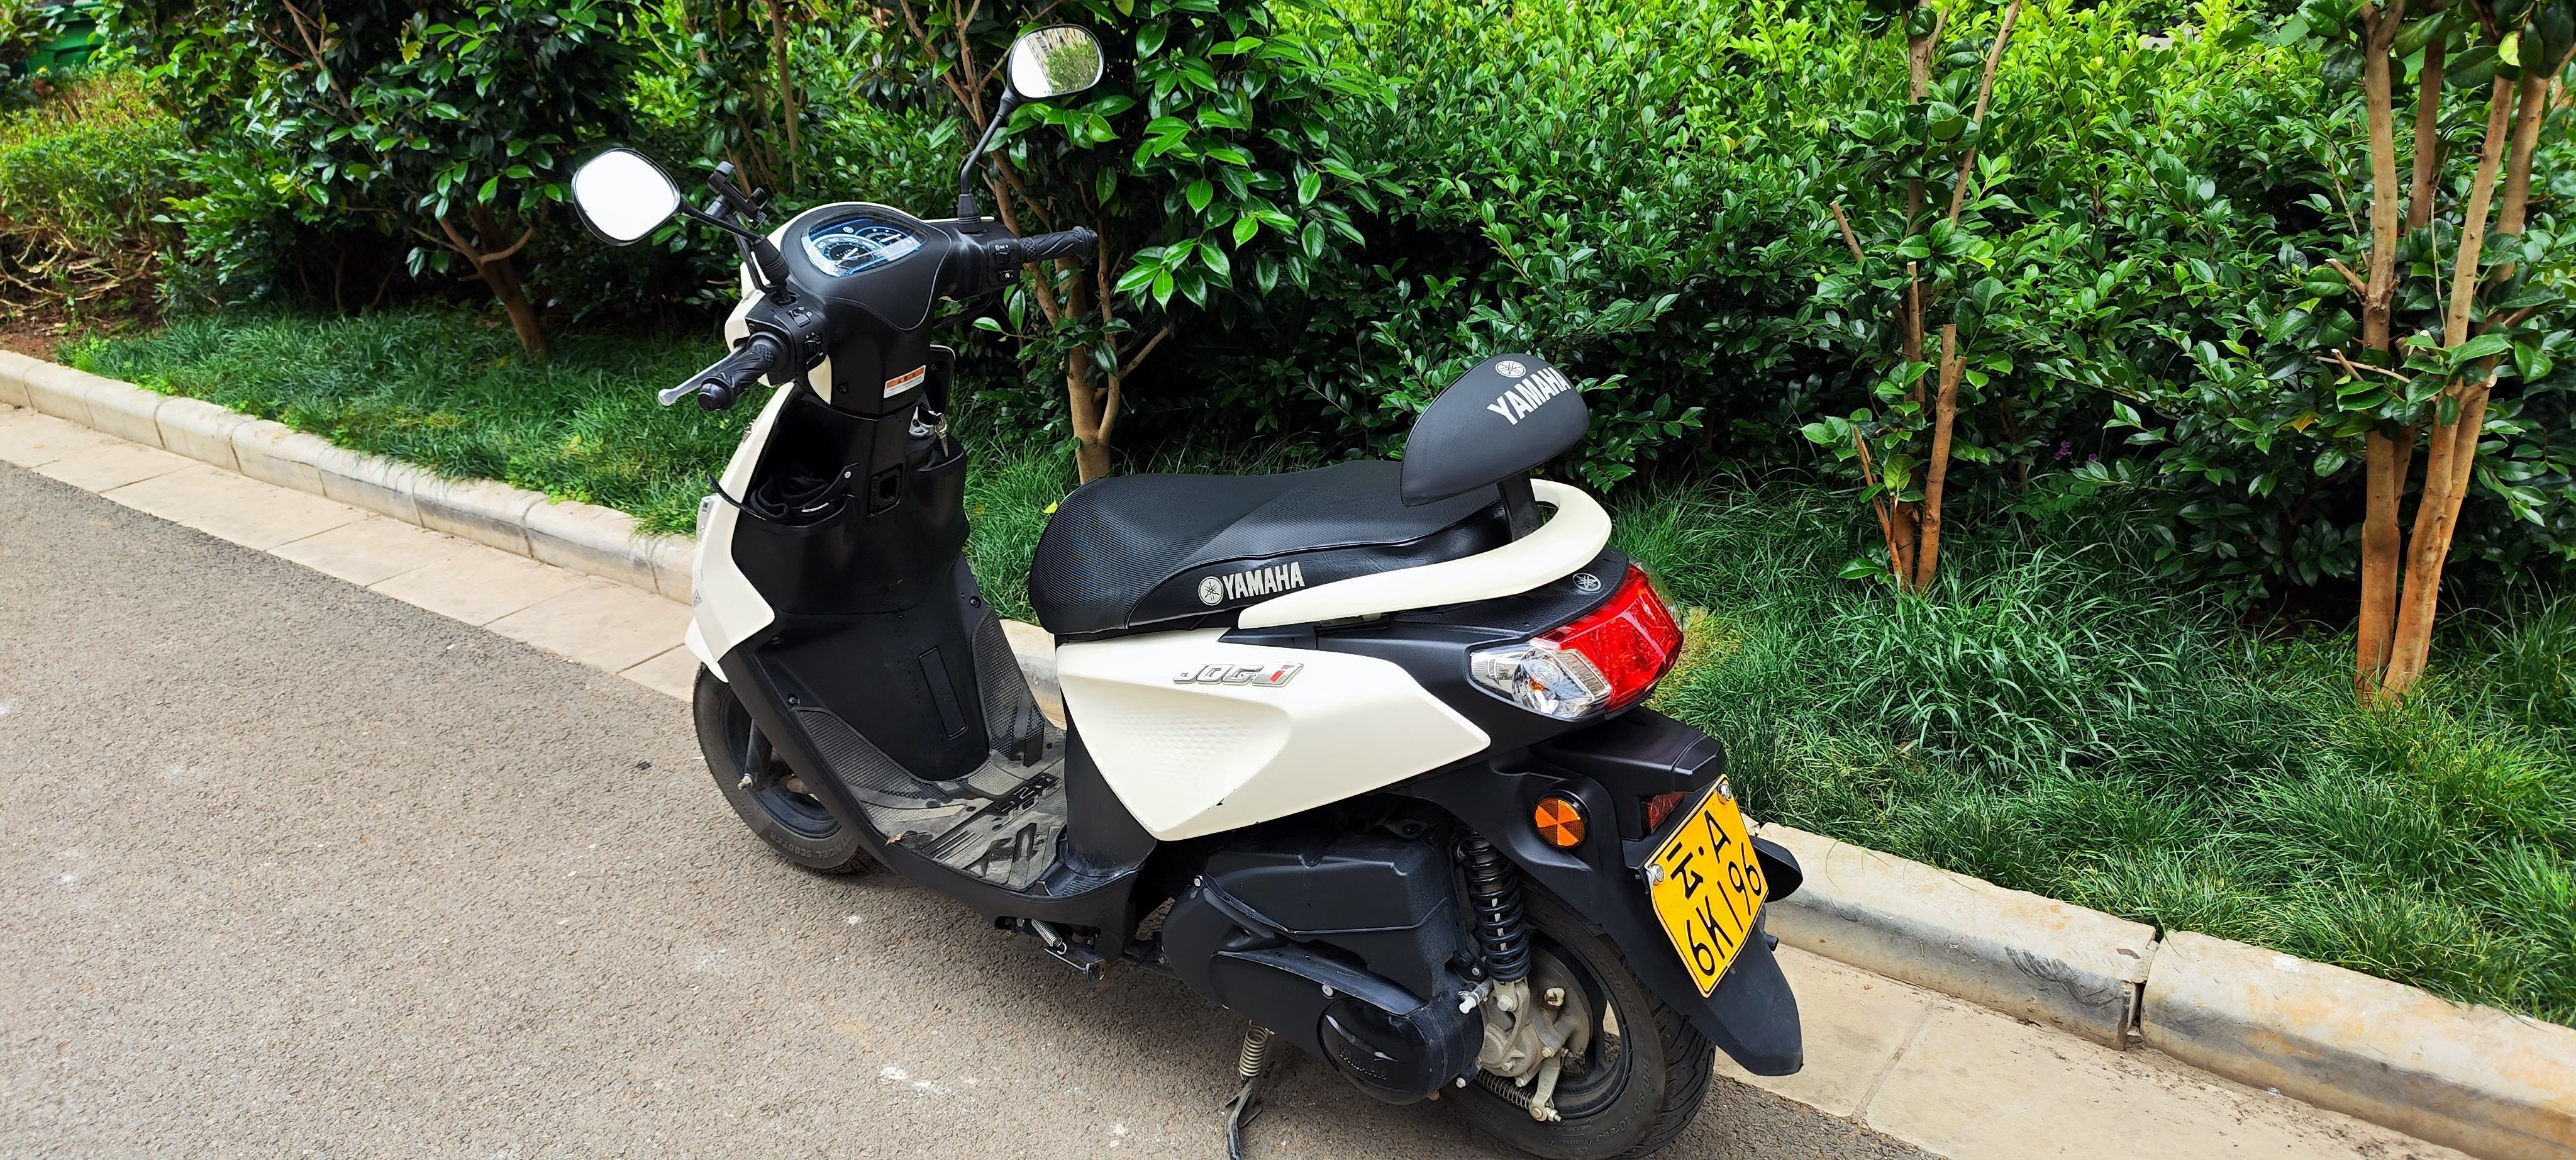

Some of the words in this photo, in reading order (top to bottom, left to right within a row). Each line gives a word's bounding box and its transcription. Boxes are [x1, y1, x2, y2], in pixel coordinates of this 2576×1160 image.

[1486, 367, 1572, 425] YAMAHA
[1222, 561, 1306, 600] YAMAHA
[769, 832, 812, 858] SCOOTER
[1685, 842, 1762, 976] 6K196
